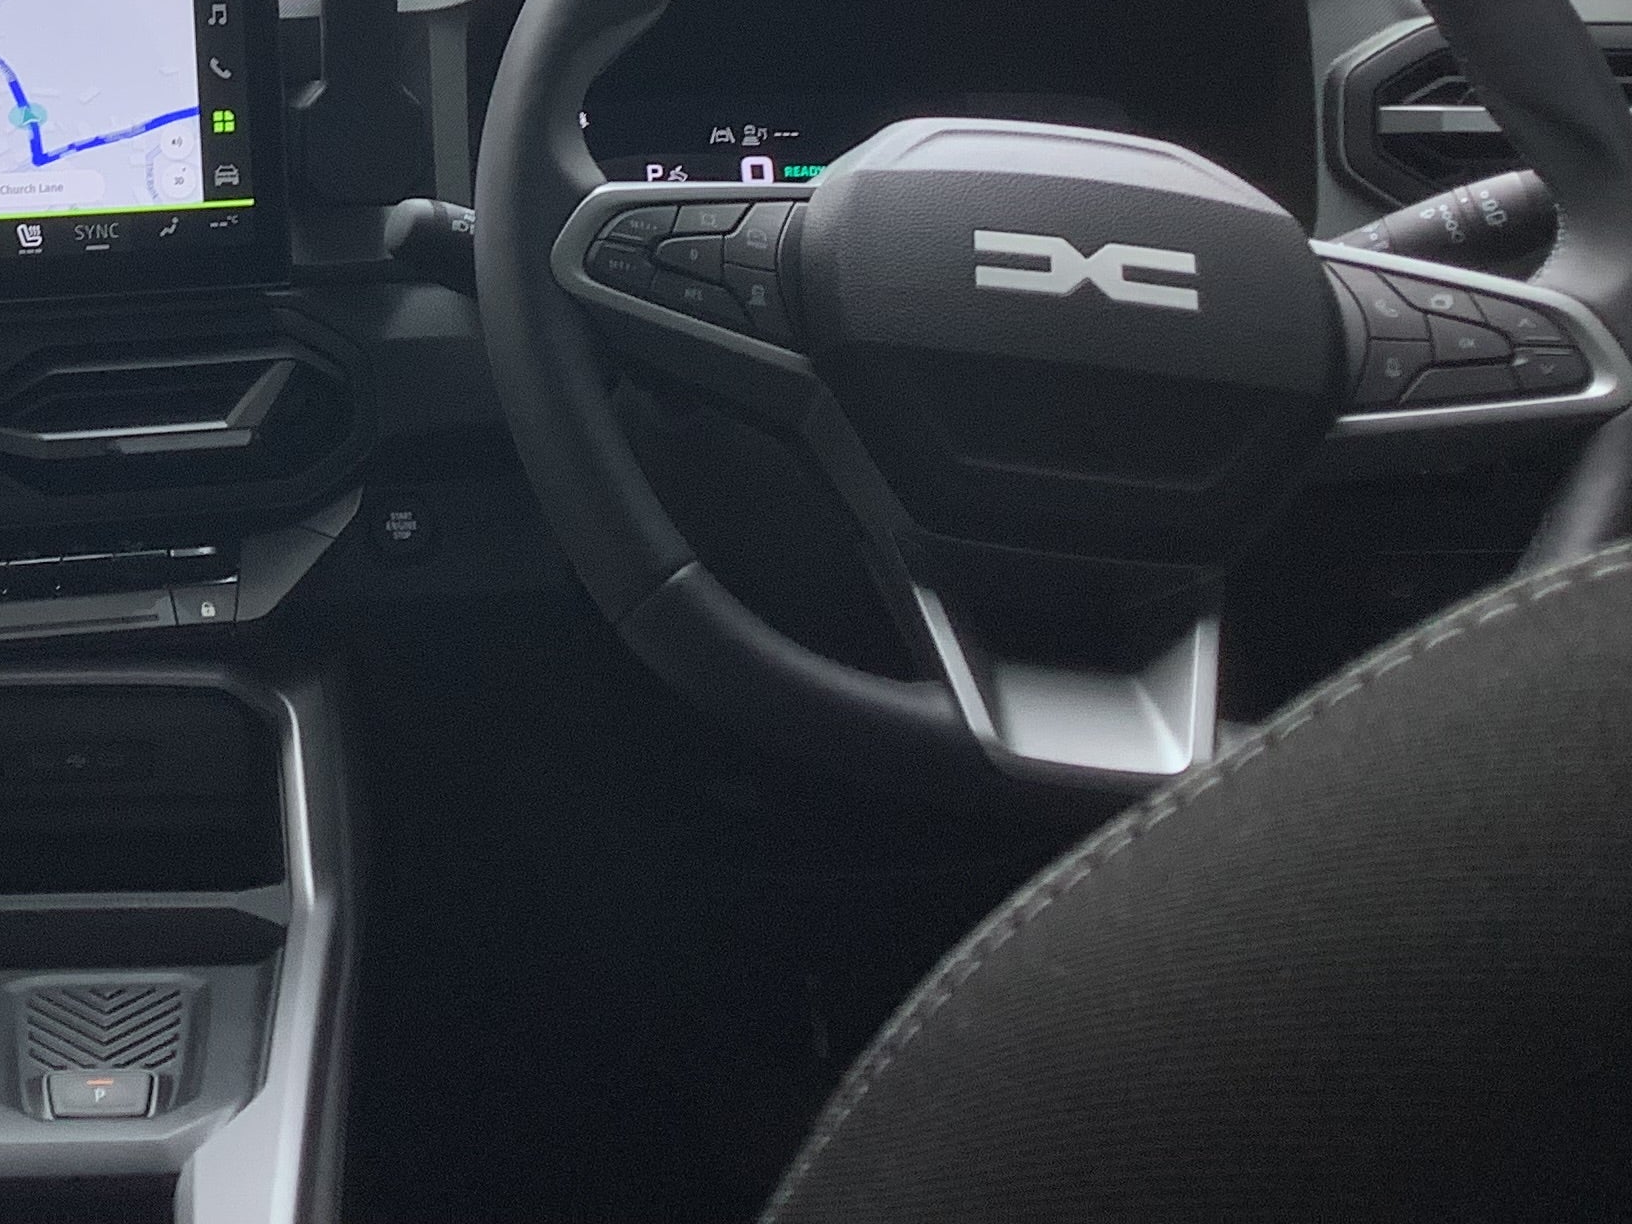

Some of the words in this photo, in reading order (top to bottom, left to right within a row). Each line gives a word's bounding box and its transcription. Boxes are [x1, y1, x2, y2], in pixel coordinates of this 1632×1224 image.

[646, 164, 664, 182] P
[0, 184, 37, 195] Church
[39, 183, 65, 193] Lane
[74, 223, 119, 240] SYNC
